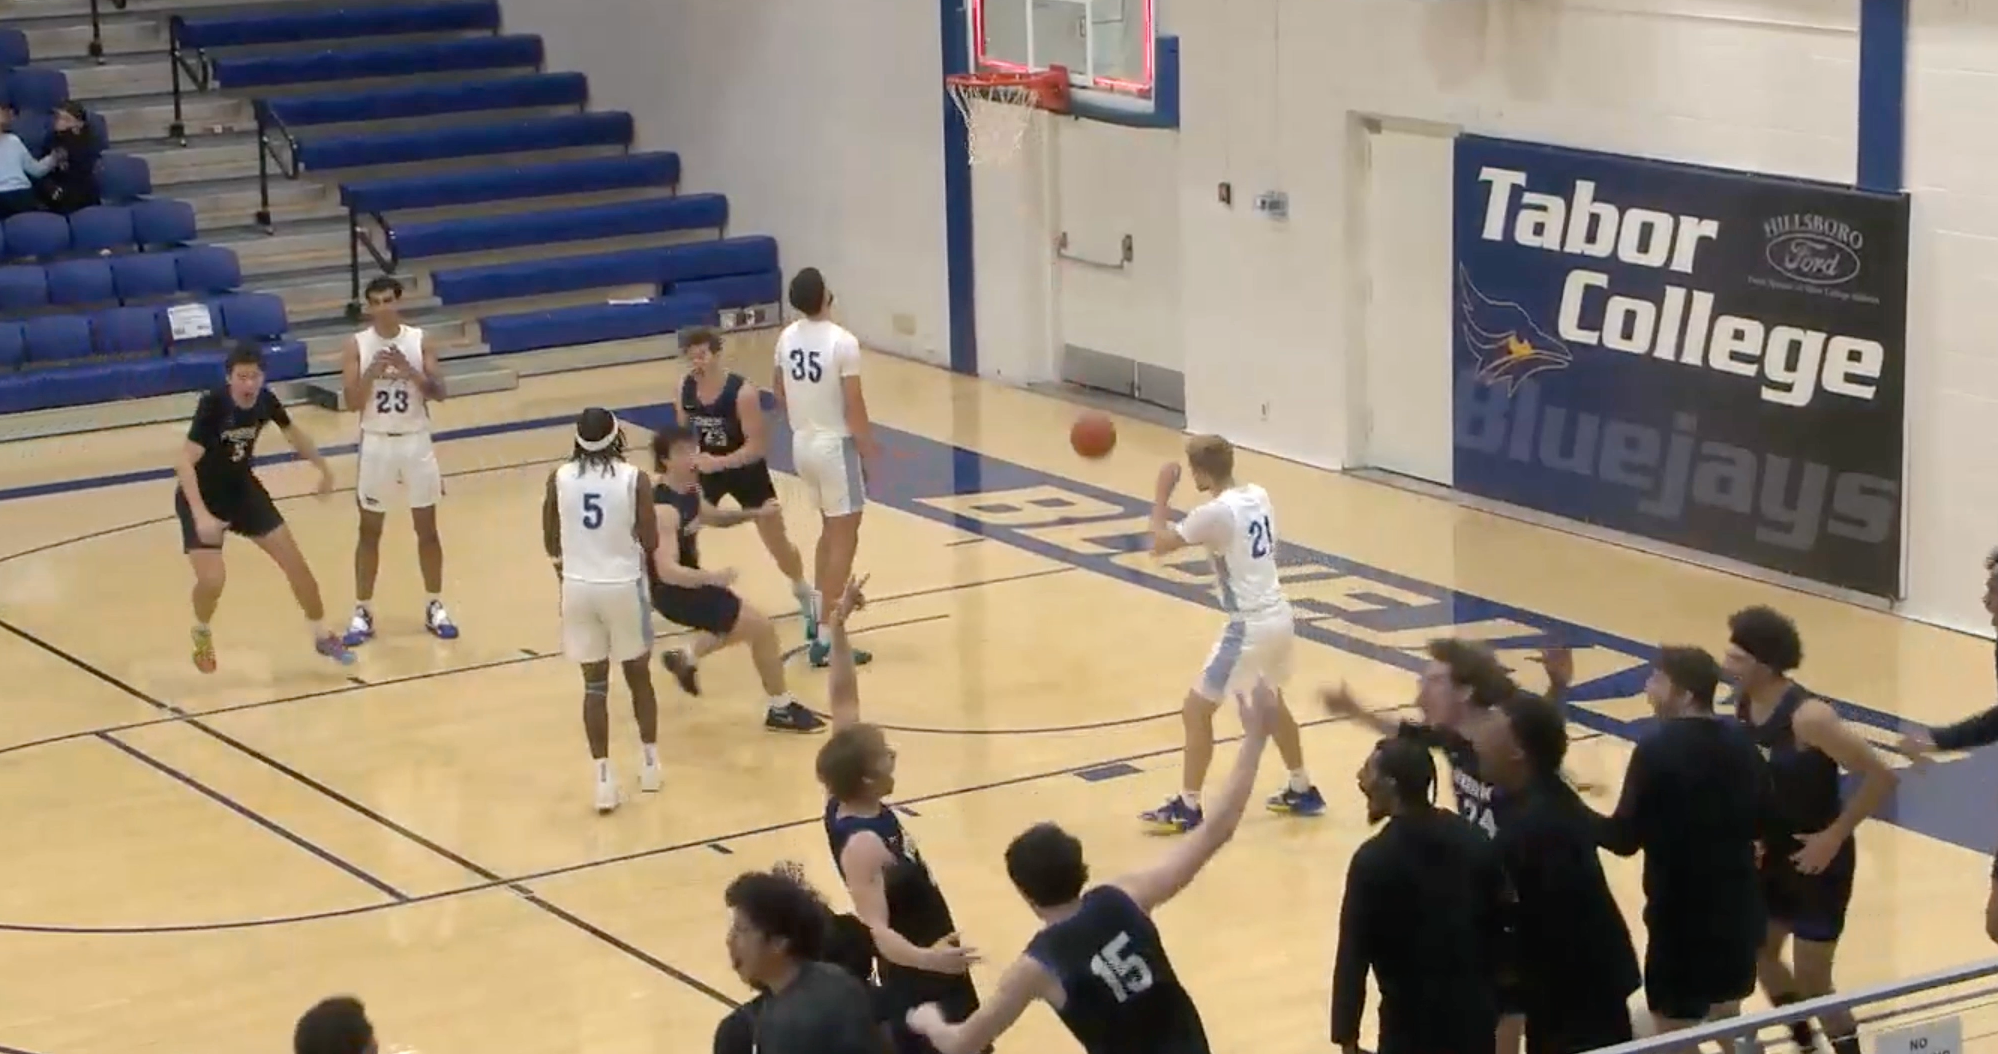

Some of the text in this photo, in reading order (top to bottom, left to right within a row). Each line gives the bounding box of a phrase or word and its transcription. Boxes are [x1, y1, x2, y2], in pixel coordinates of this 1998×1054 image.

[1478, 167, 1719, 274] Tabor
[1764, 213, 1863, 250] HILLSBORO
[1784, 239, 1840, 276] Ford
[1558, 269, 1884, 408] College
[789, 348, 822, 384] 35
[376, 388, 409, 414] 23
[1455, 365, 1899, 552] Bluejays
[582, 493, 604, 530] 5
[1248, 515, 1273, 560] 21
[1090, 930, 1153, 1003] 15
[1910, 1038, 1928, 1051] NO
